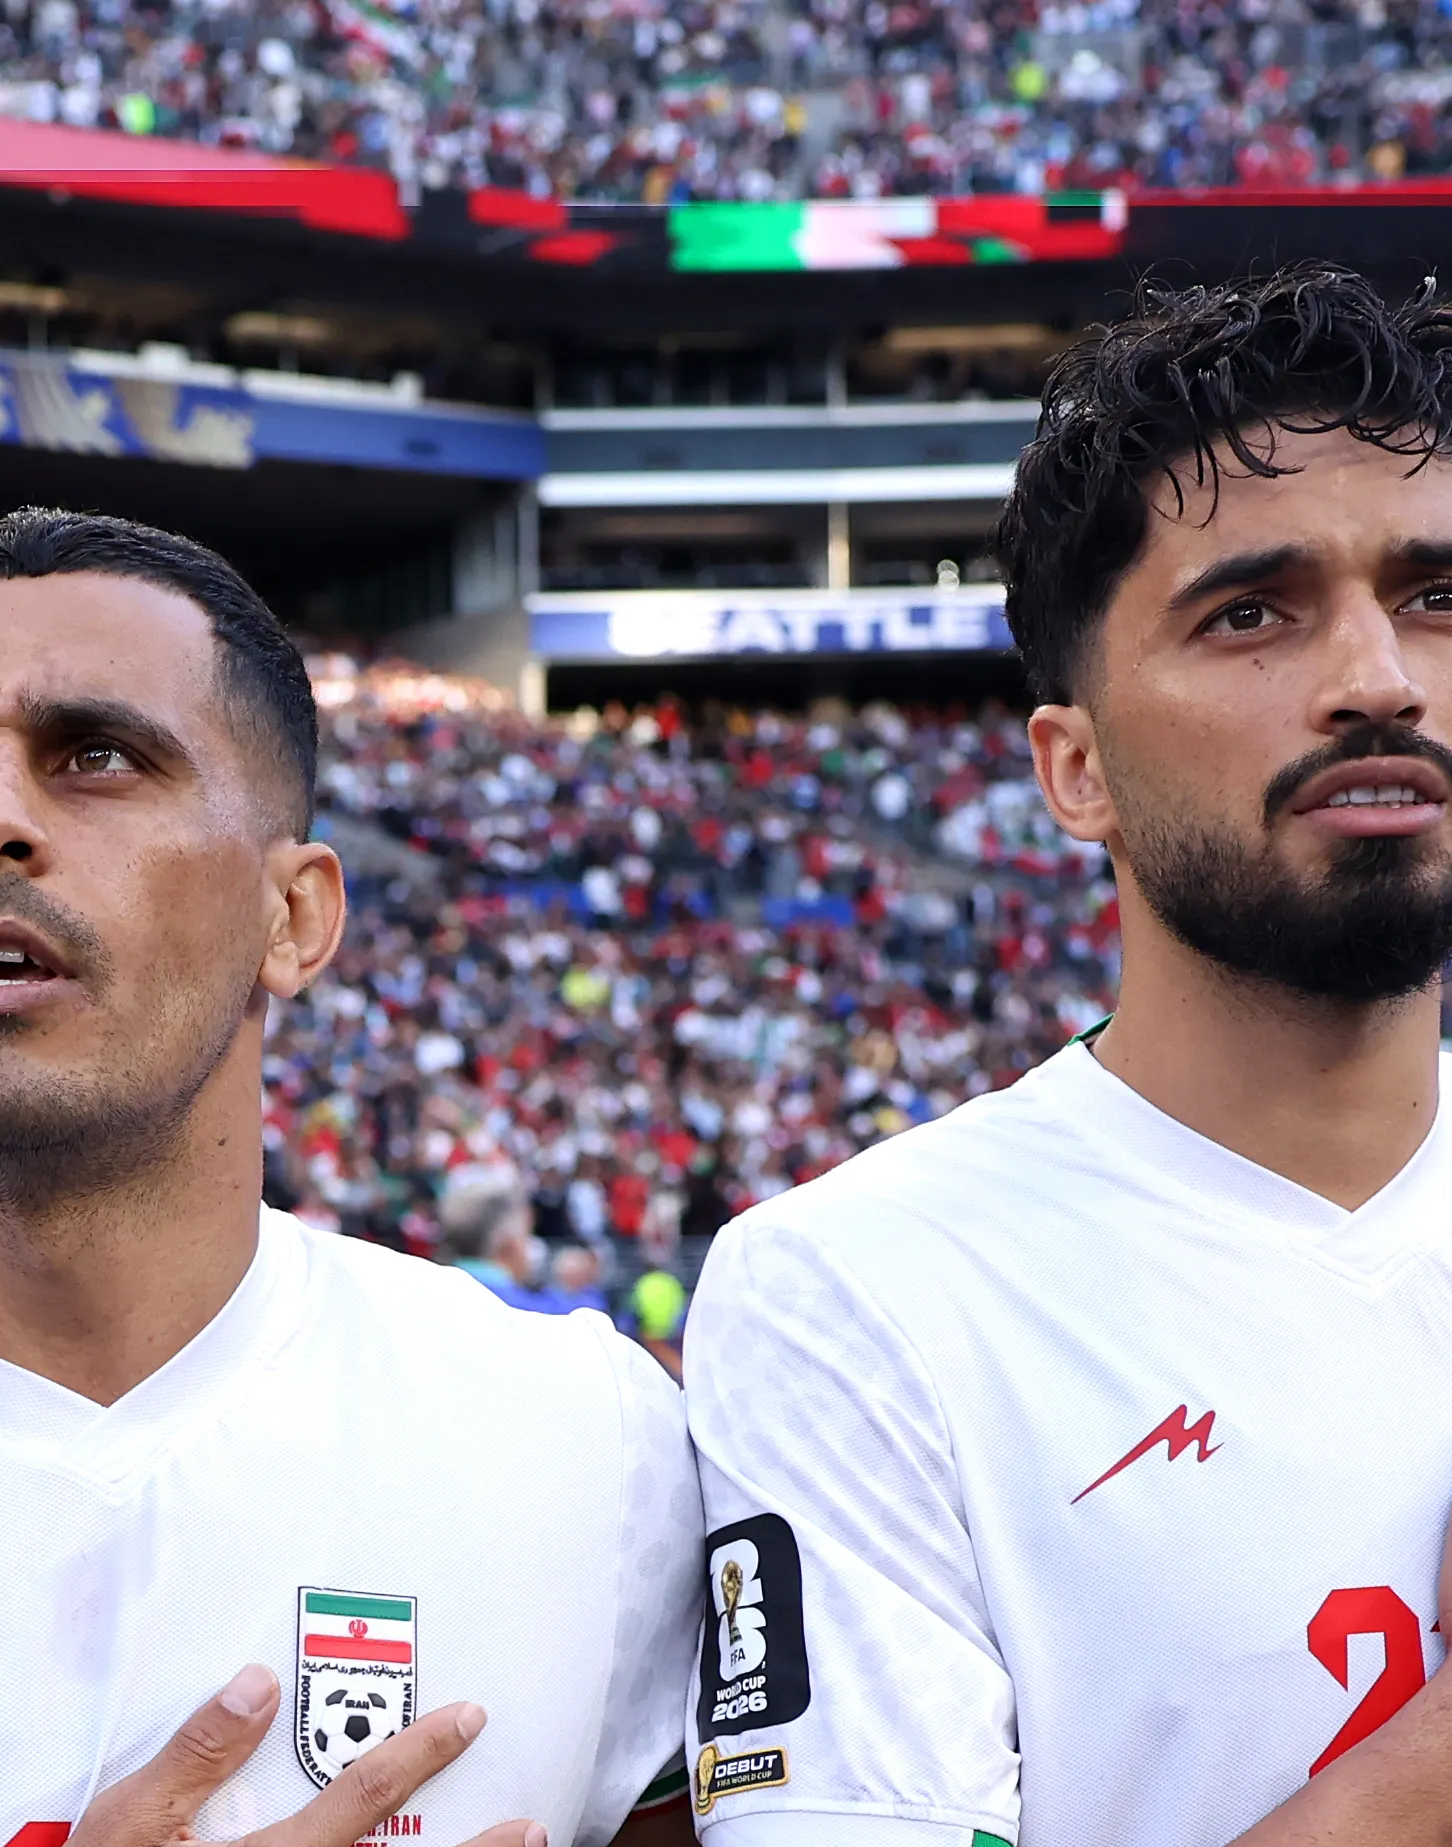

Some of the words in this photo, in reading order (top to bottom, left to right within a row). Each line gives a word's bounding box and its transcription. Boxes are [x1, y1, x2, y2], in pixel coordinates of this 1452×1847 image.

[730, 1648, 746, 1667] FFA
[742, 1675, 767, 1691] CUP
[300, 1675, 310, 1734] FOOTBALL
[345, 1699, 370, 1710] IRAN
[403, 1683, 412, 1713] IRAN
[711, 1691, 768, 1722] 2026
[714, 1754, 778, 1779] DEBUT
[731, 1773, 756, 1783] WORLD
[756, 1770, 773, 1780] CUP
